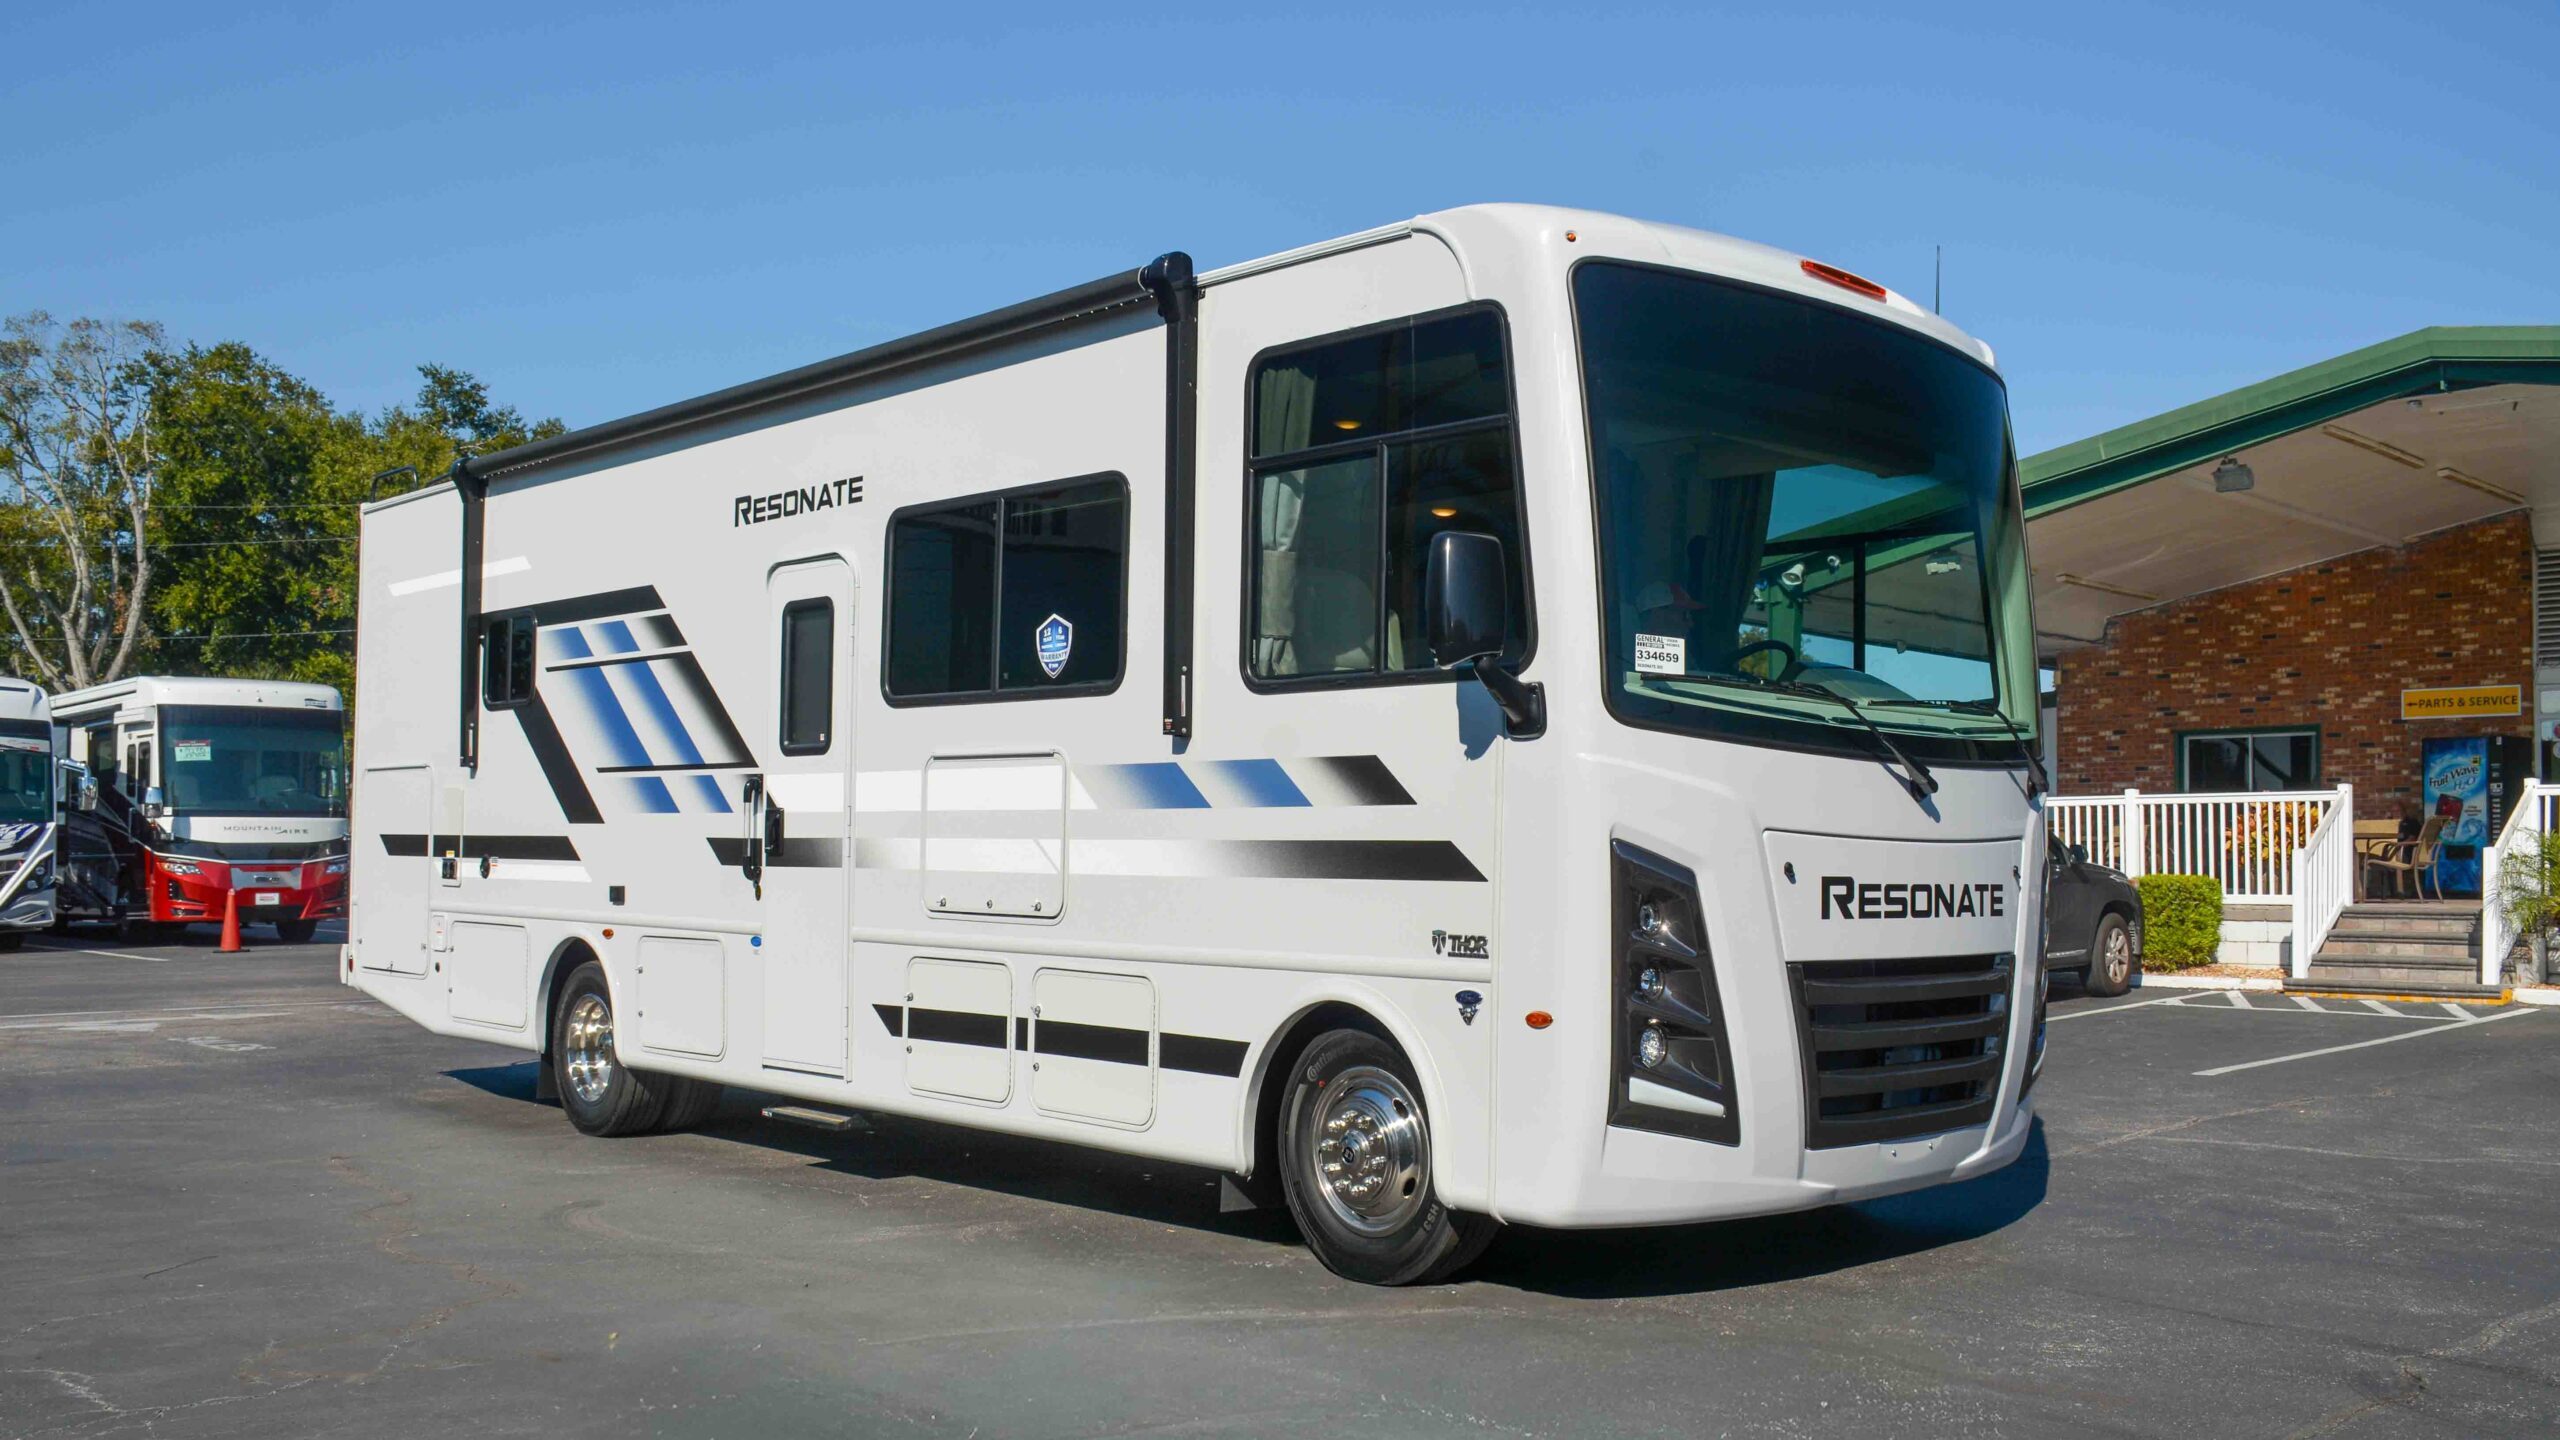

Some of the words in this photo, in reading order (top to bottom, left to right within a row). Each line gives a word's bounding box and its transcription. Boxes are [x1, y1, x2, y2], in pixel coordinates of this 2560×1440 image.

[734, 475, 864, 528] RESONATE
[1637, 634, 1664, 643] GENERAL
[1637, 650, 1679, 663] 334659
[2418, 697, 2454, 709] PARTS
[2457, 696, 2465, 707] &
[2468, 695, 2518, 706] SERVICE
[2429, 774, 2448, 788] Fruit
[2450, 766, 2479, 779] Wave
[1820, 875, 2005, 920] RESONATE
[1447, 934, 1489, 954] THOR
